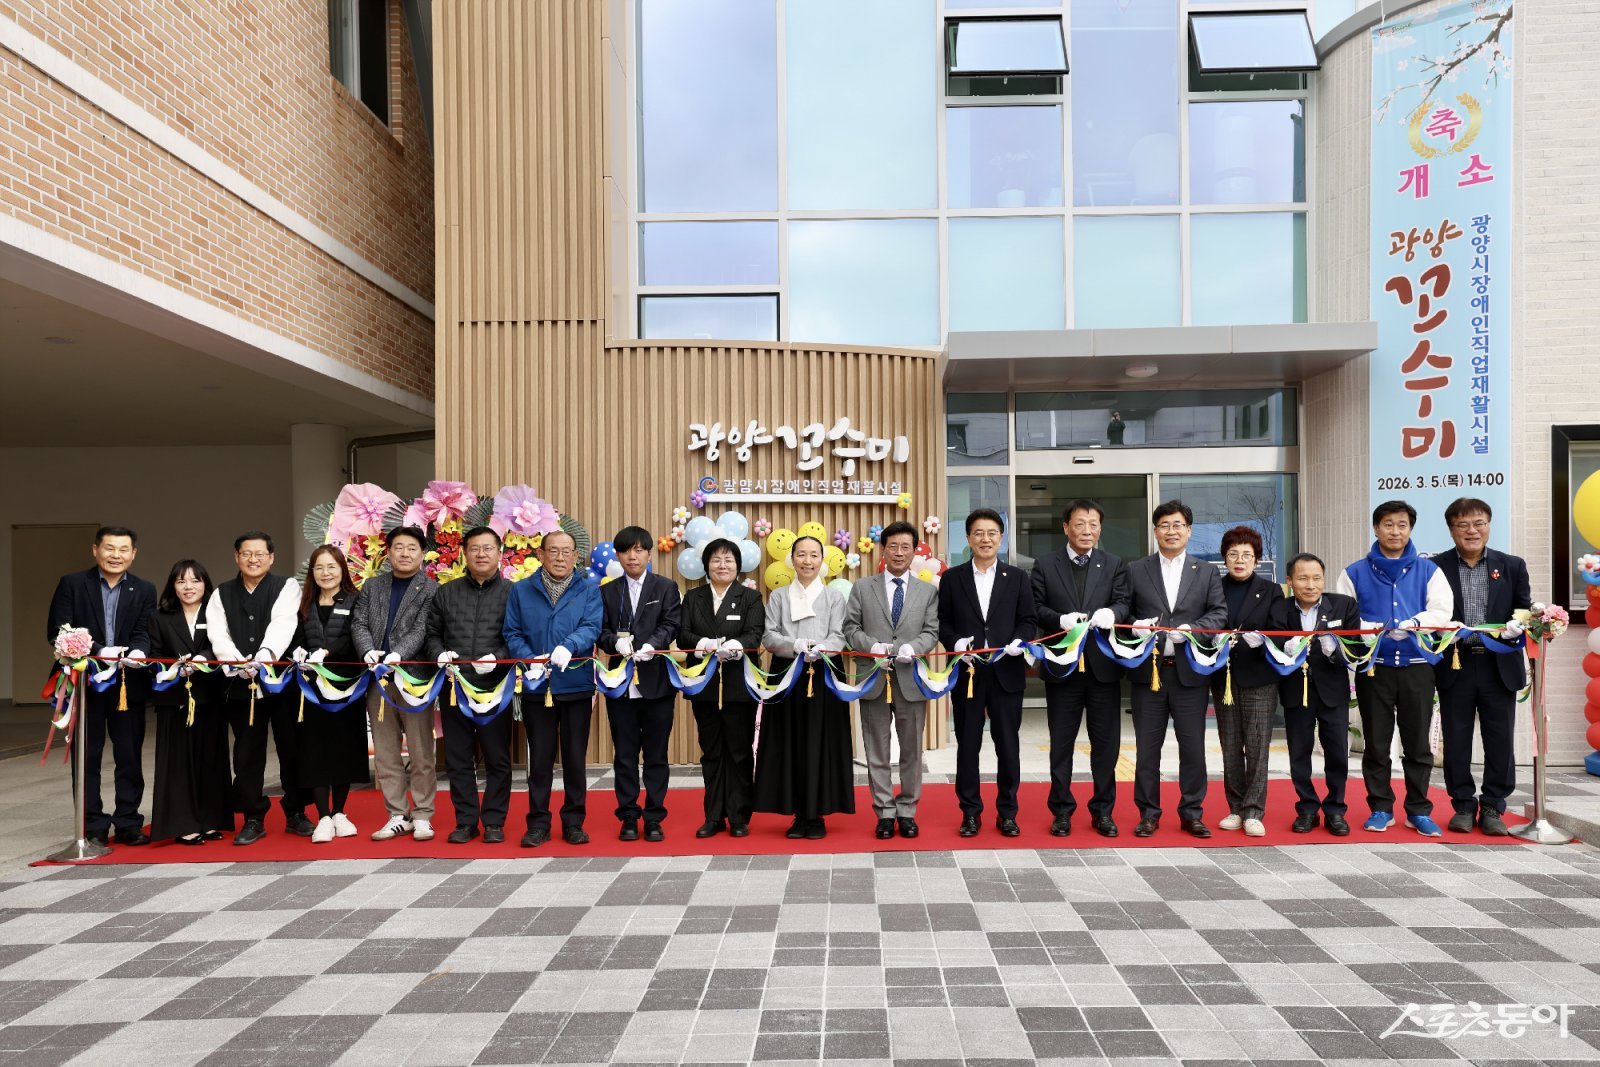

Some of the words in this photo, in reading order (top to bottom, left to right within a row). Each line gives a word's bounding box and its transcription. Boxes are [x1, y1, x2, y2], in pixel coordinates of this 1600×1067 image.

[1426, 107, 1462, 141] 축
[1388, 219, 1463, 262] 광양
[1470, 214, 1491, 455] 광양시장애인직업재활시설
[688, 419, 773, 462] 광양
[723, 479, 902, 495] 광양시장애인직업재활시설
[1377, 477, 1413, 490] 2026.
[1467, 472, 1504, 487] 14:00
